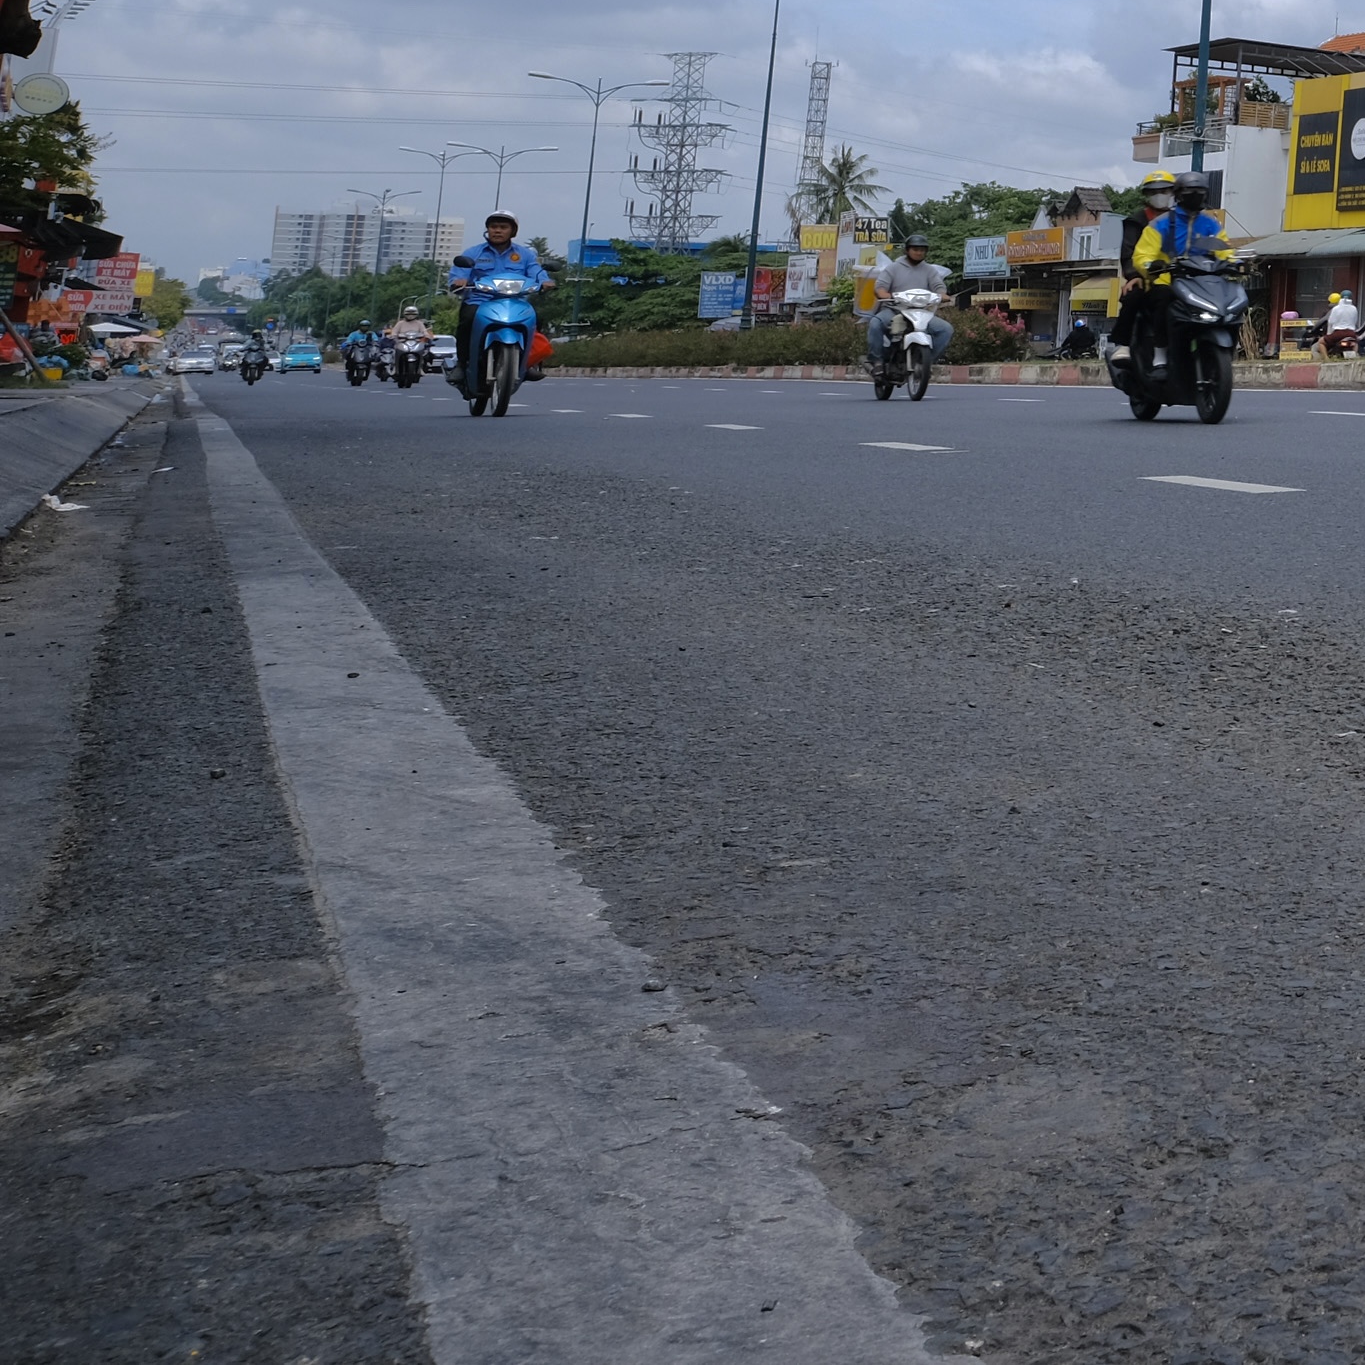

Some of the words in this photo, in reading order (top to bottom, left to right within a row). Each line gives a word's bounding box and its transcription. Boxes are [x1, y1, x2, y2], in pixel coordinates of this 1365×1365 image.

[1317, 159, 1330, 172] SOFA
[855, 218, 868, 229] 47
[870, 218, 888, 229] Tea
[113, 268, 131, 276] MÁY
[703, 275, 735, 284] VLXD
[110, 292, 132, 301] MÁY
[108, 302, 131, 312] ĐIỆN
